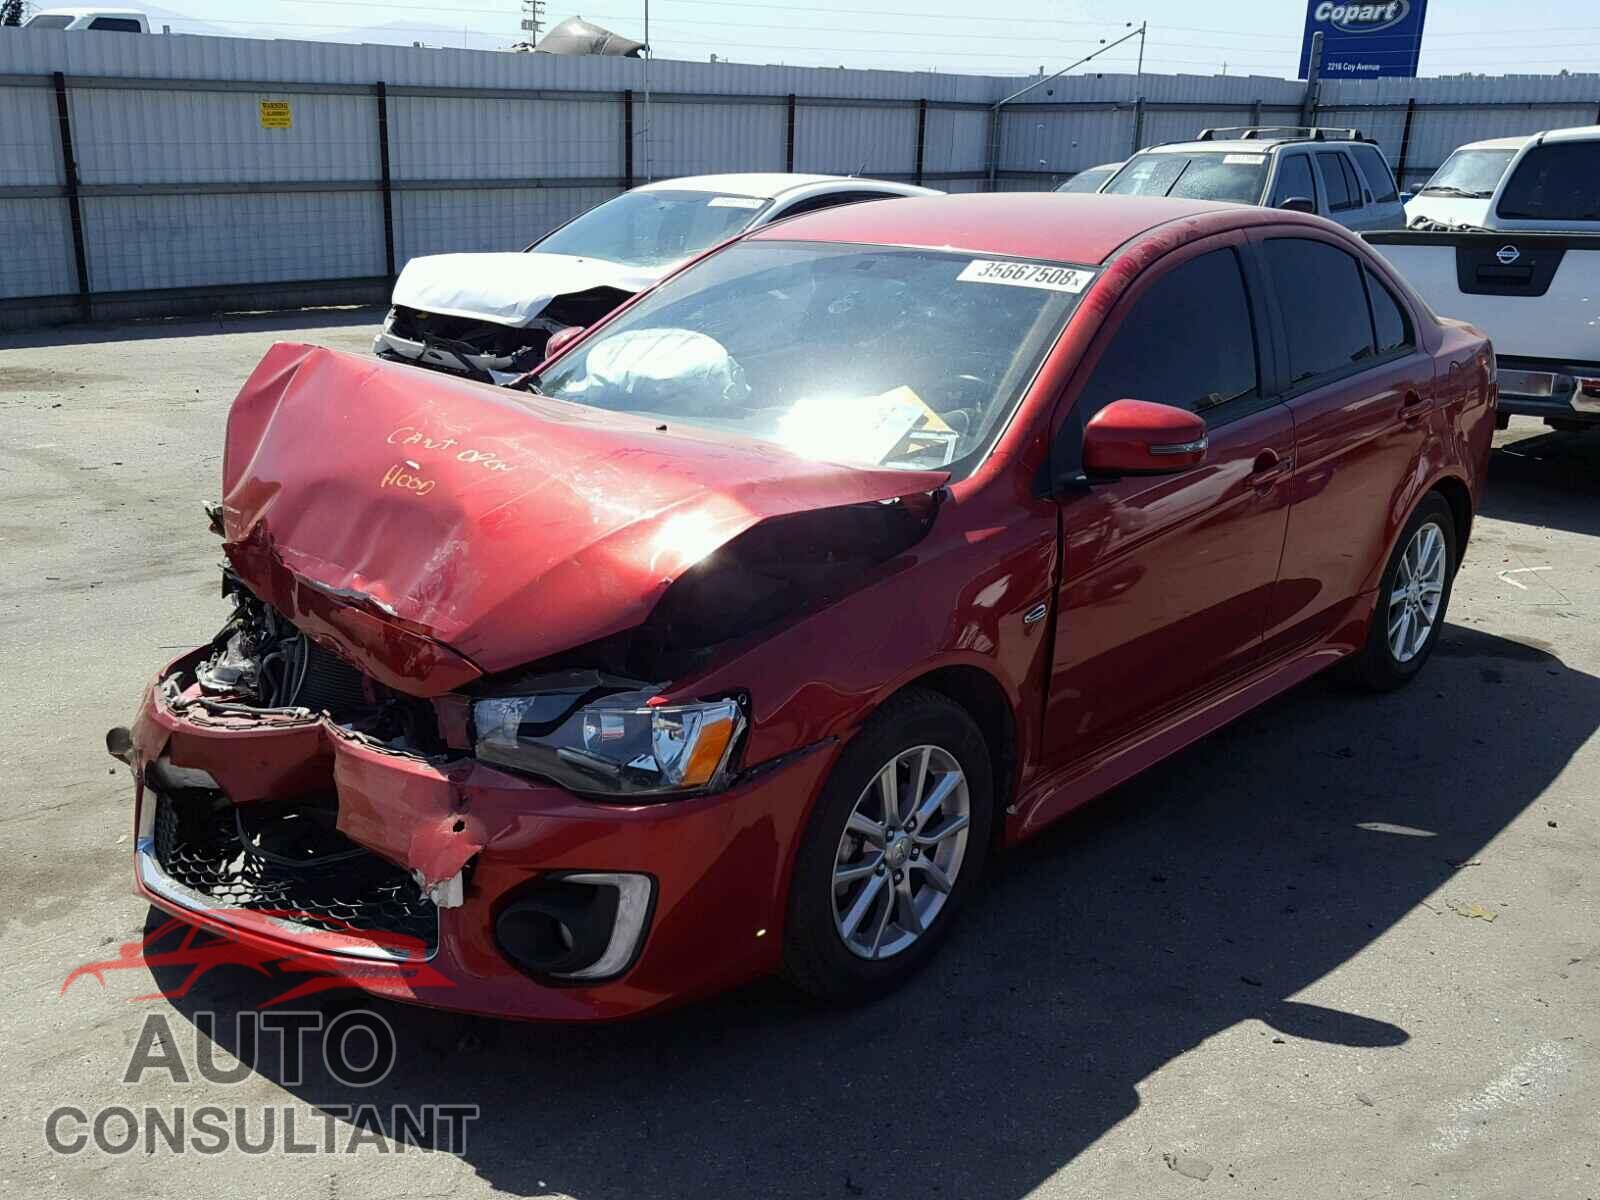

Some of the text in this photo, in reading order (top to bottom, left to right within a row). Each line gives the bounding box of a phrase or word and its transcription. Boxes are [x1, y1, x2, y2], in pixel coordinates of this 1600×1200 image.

[1314, 1, 1399, 24] Copart
[1343, 62, 1356, 72] Coy
[1357, 63, 1381, 72] Avenue
